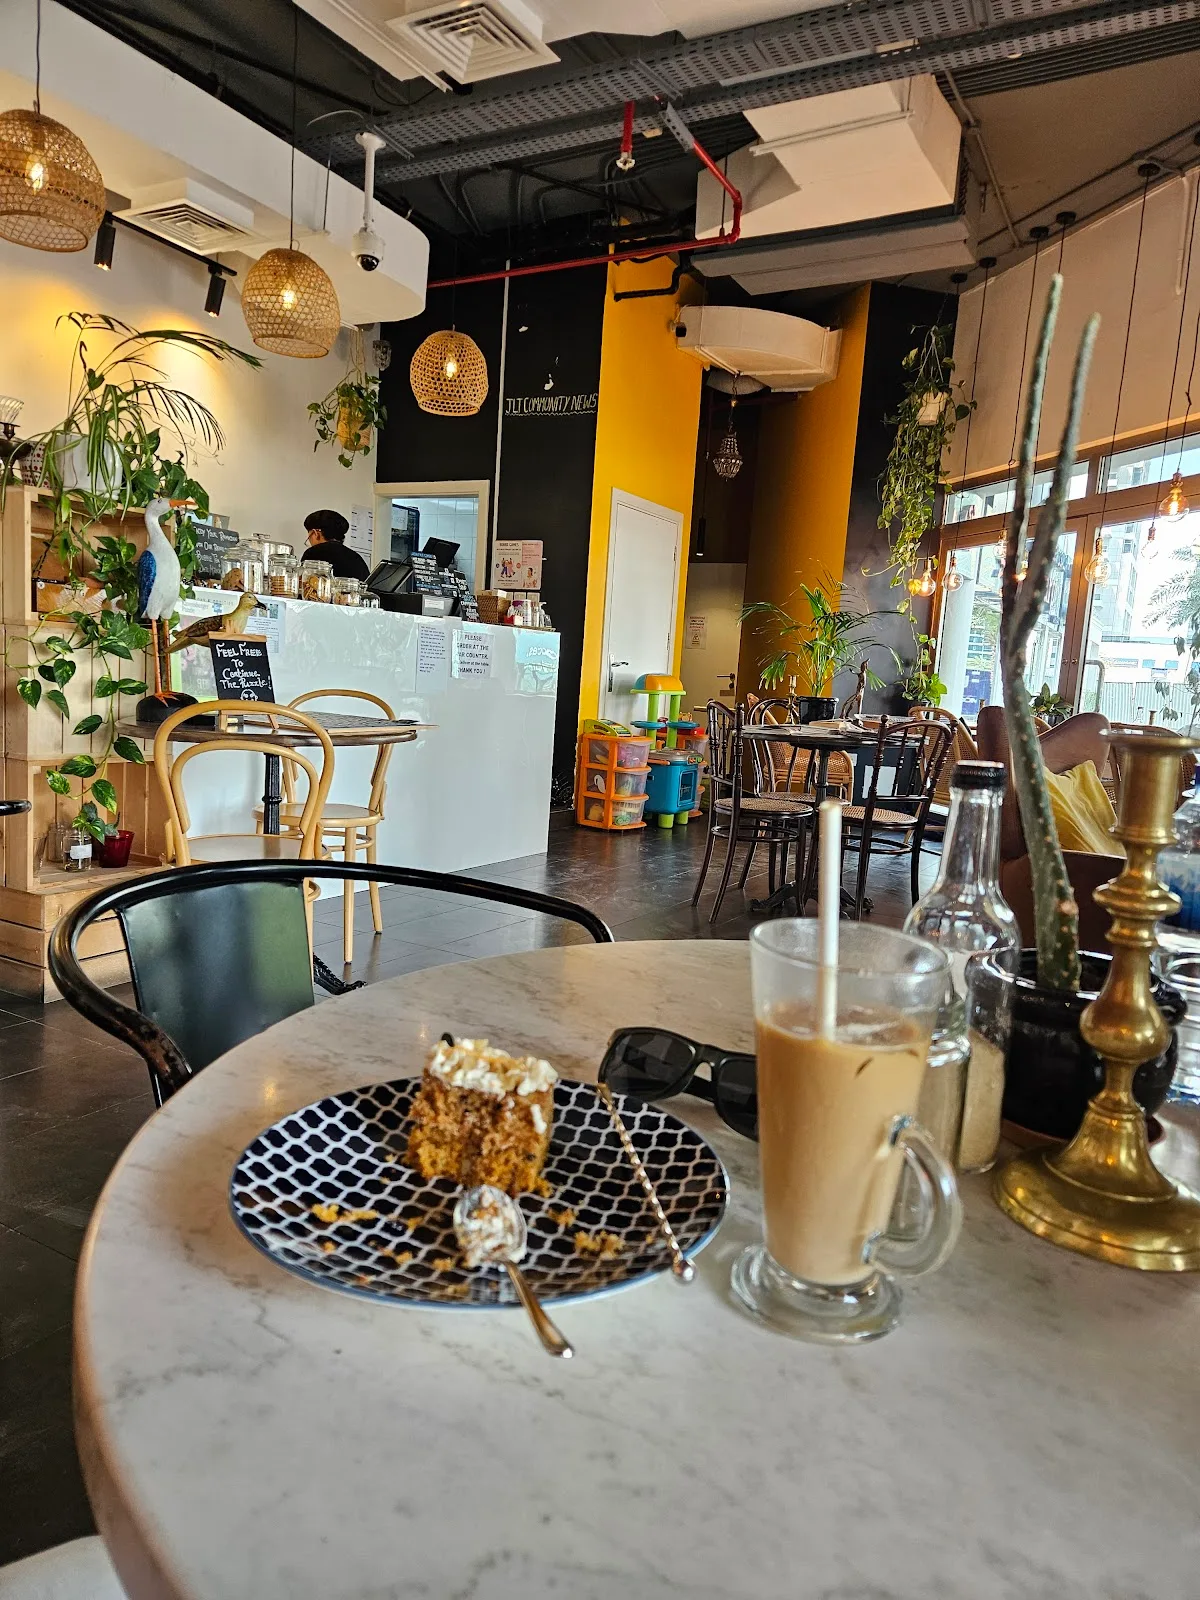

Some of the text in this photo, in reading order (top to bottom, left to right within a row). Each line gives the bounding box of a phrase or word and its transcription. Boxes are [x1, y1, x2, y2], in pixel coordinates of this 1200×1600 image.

[505, 393, 598, 413] JLT COMMUNITY NEWS
[464, 634, 482, 642] PLEASE
